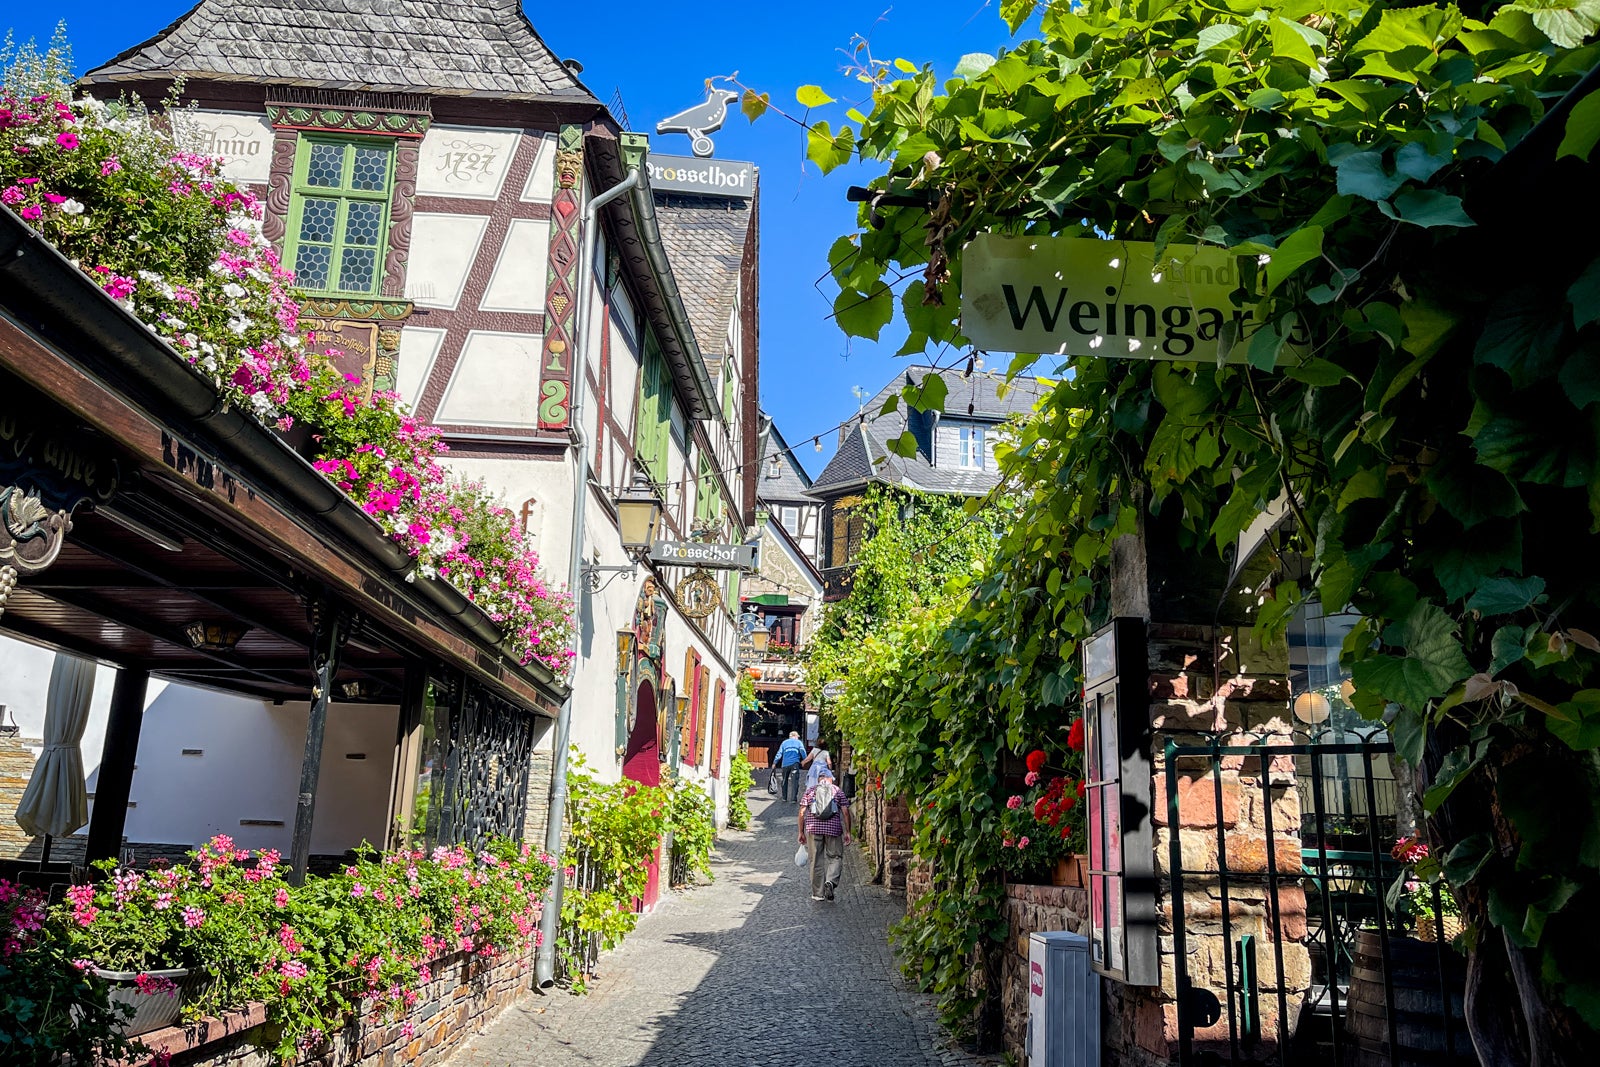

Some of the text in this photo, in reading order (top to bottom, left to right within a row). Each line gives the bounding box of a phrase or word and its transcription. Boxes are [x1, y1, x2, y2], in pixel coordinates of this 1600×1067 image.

[199, 129, 261, 156] Anno
[437, 152, 497, 179] 1727
[1164, 256, 1236, 286] Lind
[662, 543, 738, 561] Drosselhof
